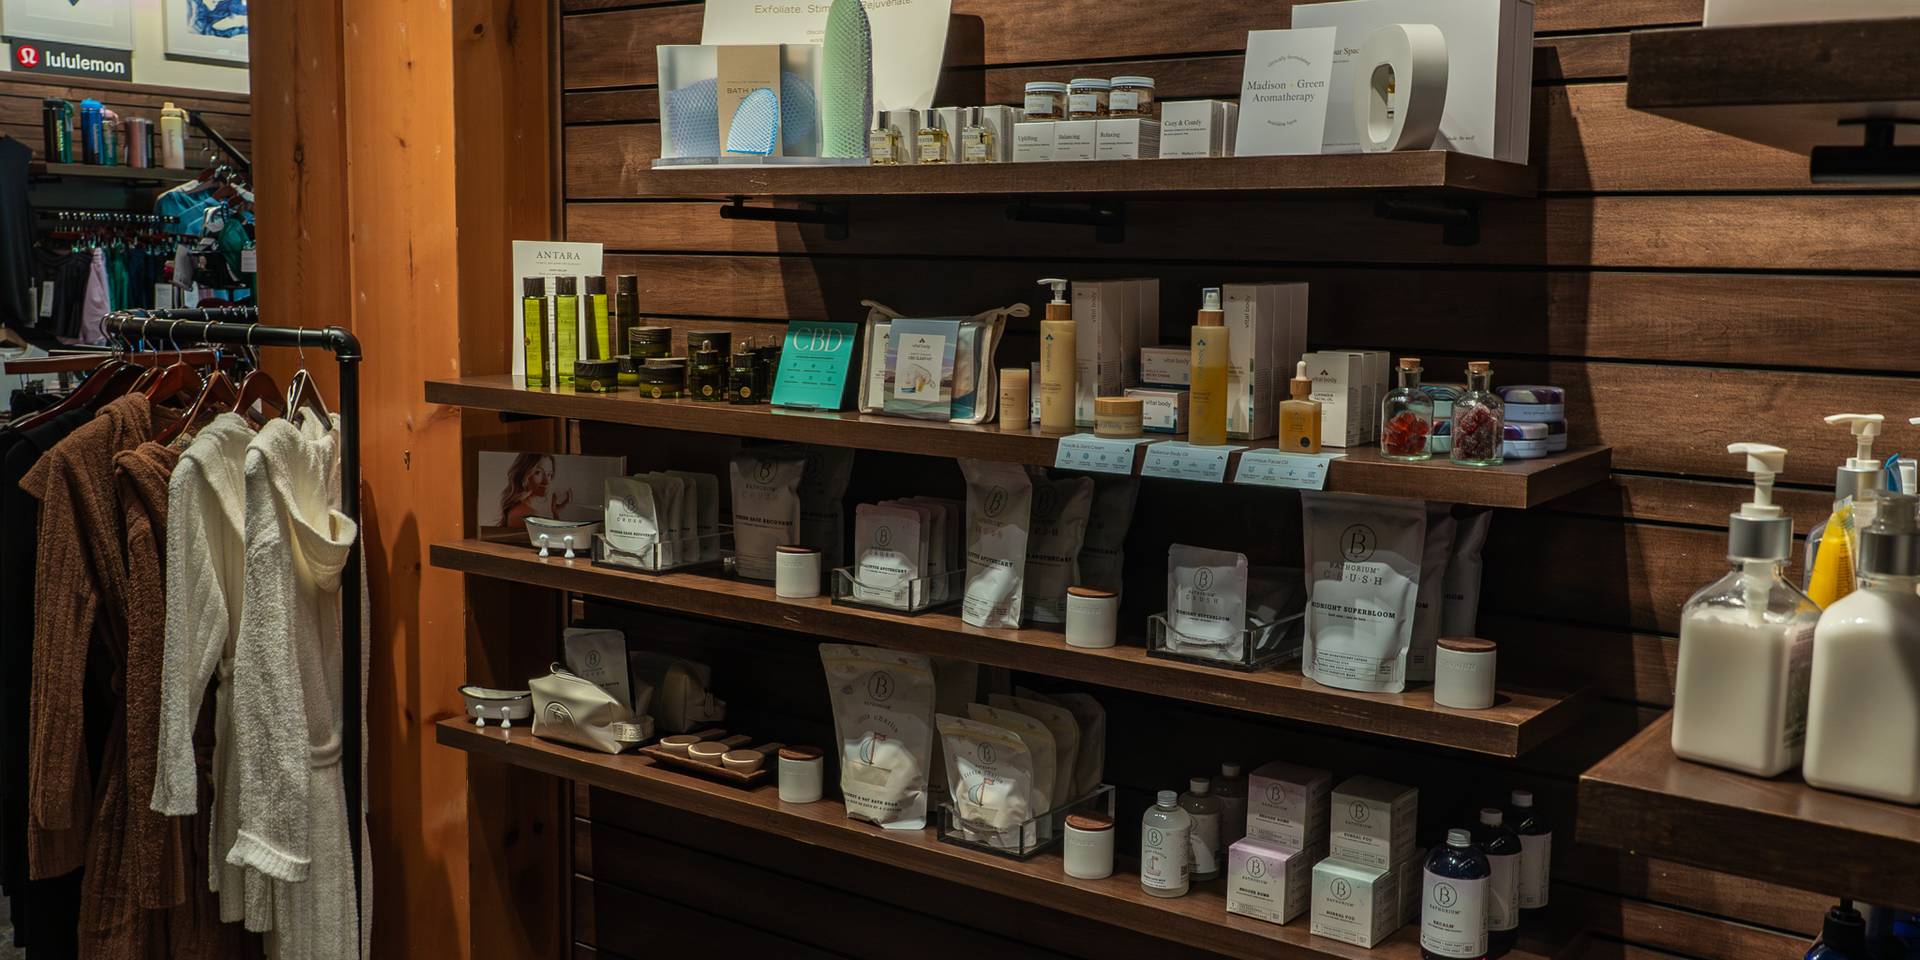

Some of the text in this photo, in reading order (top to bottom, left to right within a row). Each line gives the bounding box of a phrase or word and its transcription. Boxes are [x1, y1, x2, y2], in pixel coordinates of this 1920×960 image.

[754, 5, 803, 14] Exfoliate.
[46, 50, 125, 74] lululemon
[1247, 79, 1325, 91] Madison Green
[1252, 93, 1316, 104] Aromatherapy
[536, 250, 581, 261] ANTARA
[792, 327, 843, 353] CBD
[1158, 400, 1172, 408] body
[1343, 606, 1397, 619] SUPERBLOOM
